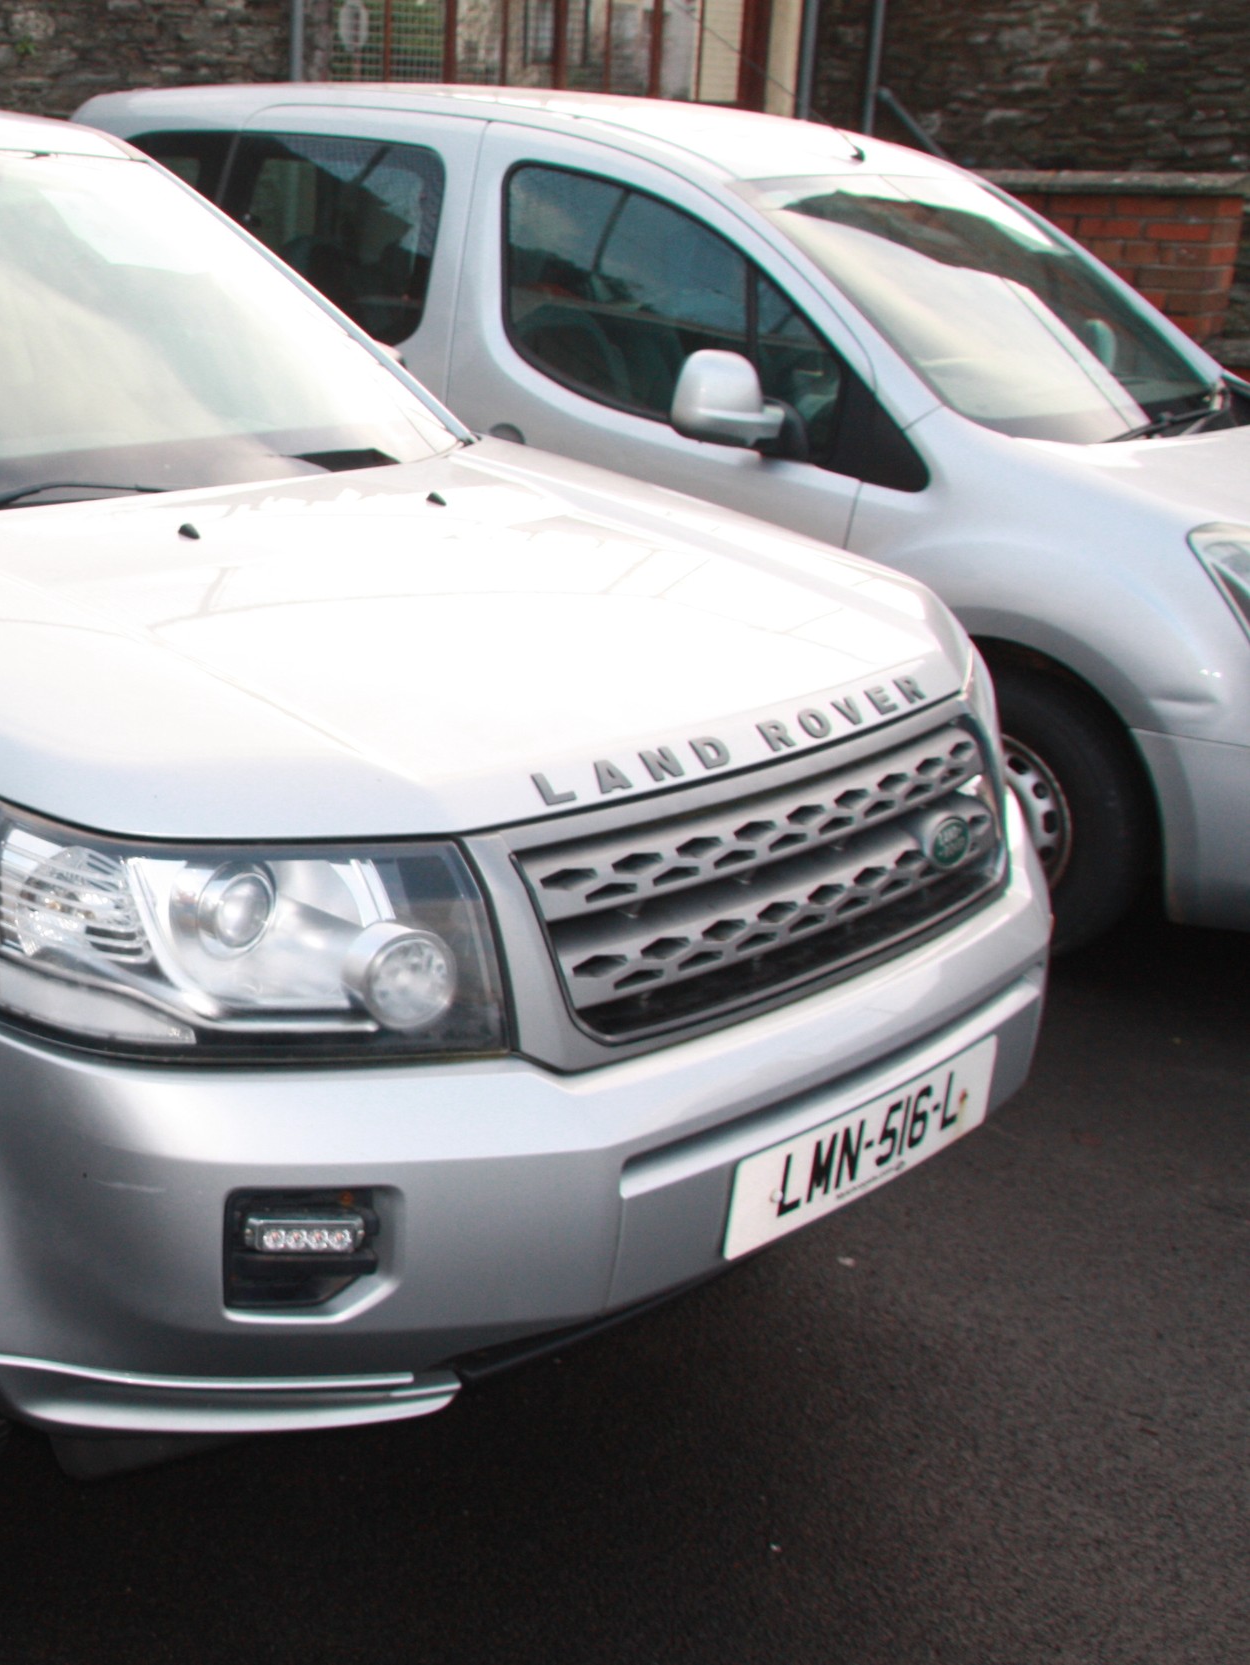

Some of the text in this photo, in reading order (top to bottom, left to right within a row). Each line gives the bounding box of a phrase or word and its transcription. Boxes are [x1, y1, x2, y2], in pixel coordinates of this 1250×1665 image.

[531, 675, 926, 806] LAND ROVER
[777, 1071, 957, 1217] LMN-516-L
